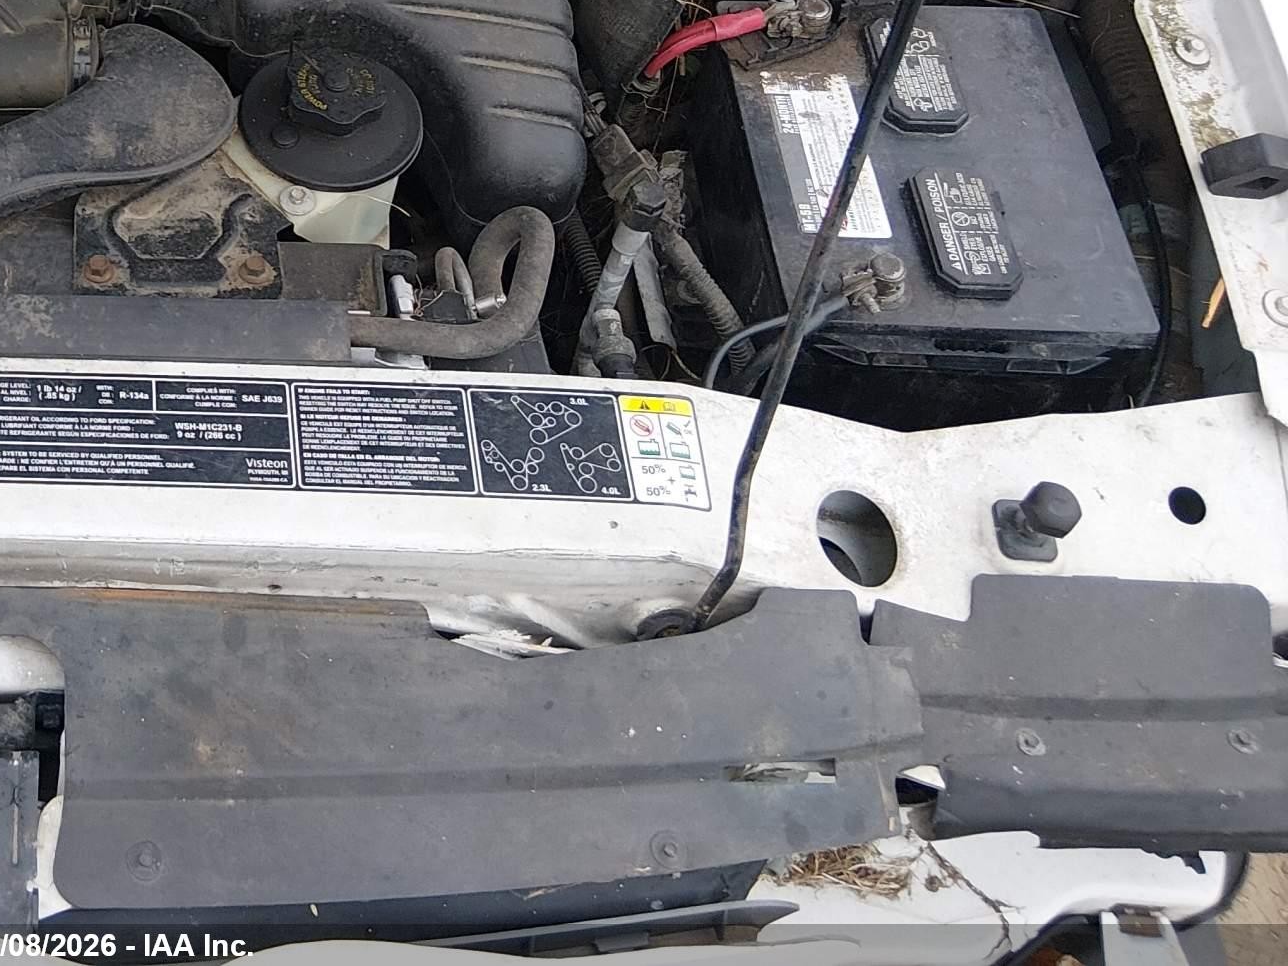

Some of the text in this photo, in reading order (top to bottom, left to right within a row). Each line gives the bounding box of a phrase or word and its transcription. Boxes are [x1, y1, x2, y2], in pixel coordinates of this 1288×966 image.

[925, 178, 960, 260] DANGER POISON
[54, 385, 63, 393] 14
[59, 393, 70, 401] kg
[119, 392, 149, 400] R-134a
[570, 397, 588, 405] 3.0L
[175, 422, 242, 432] WSH-M1C231-B
[245, 458, 288, 468] Visteon
[642, 464, 666, 474] 50%
[532, 484, 552, 492] 2.3L
